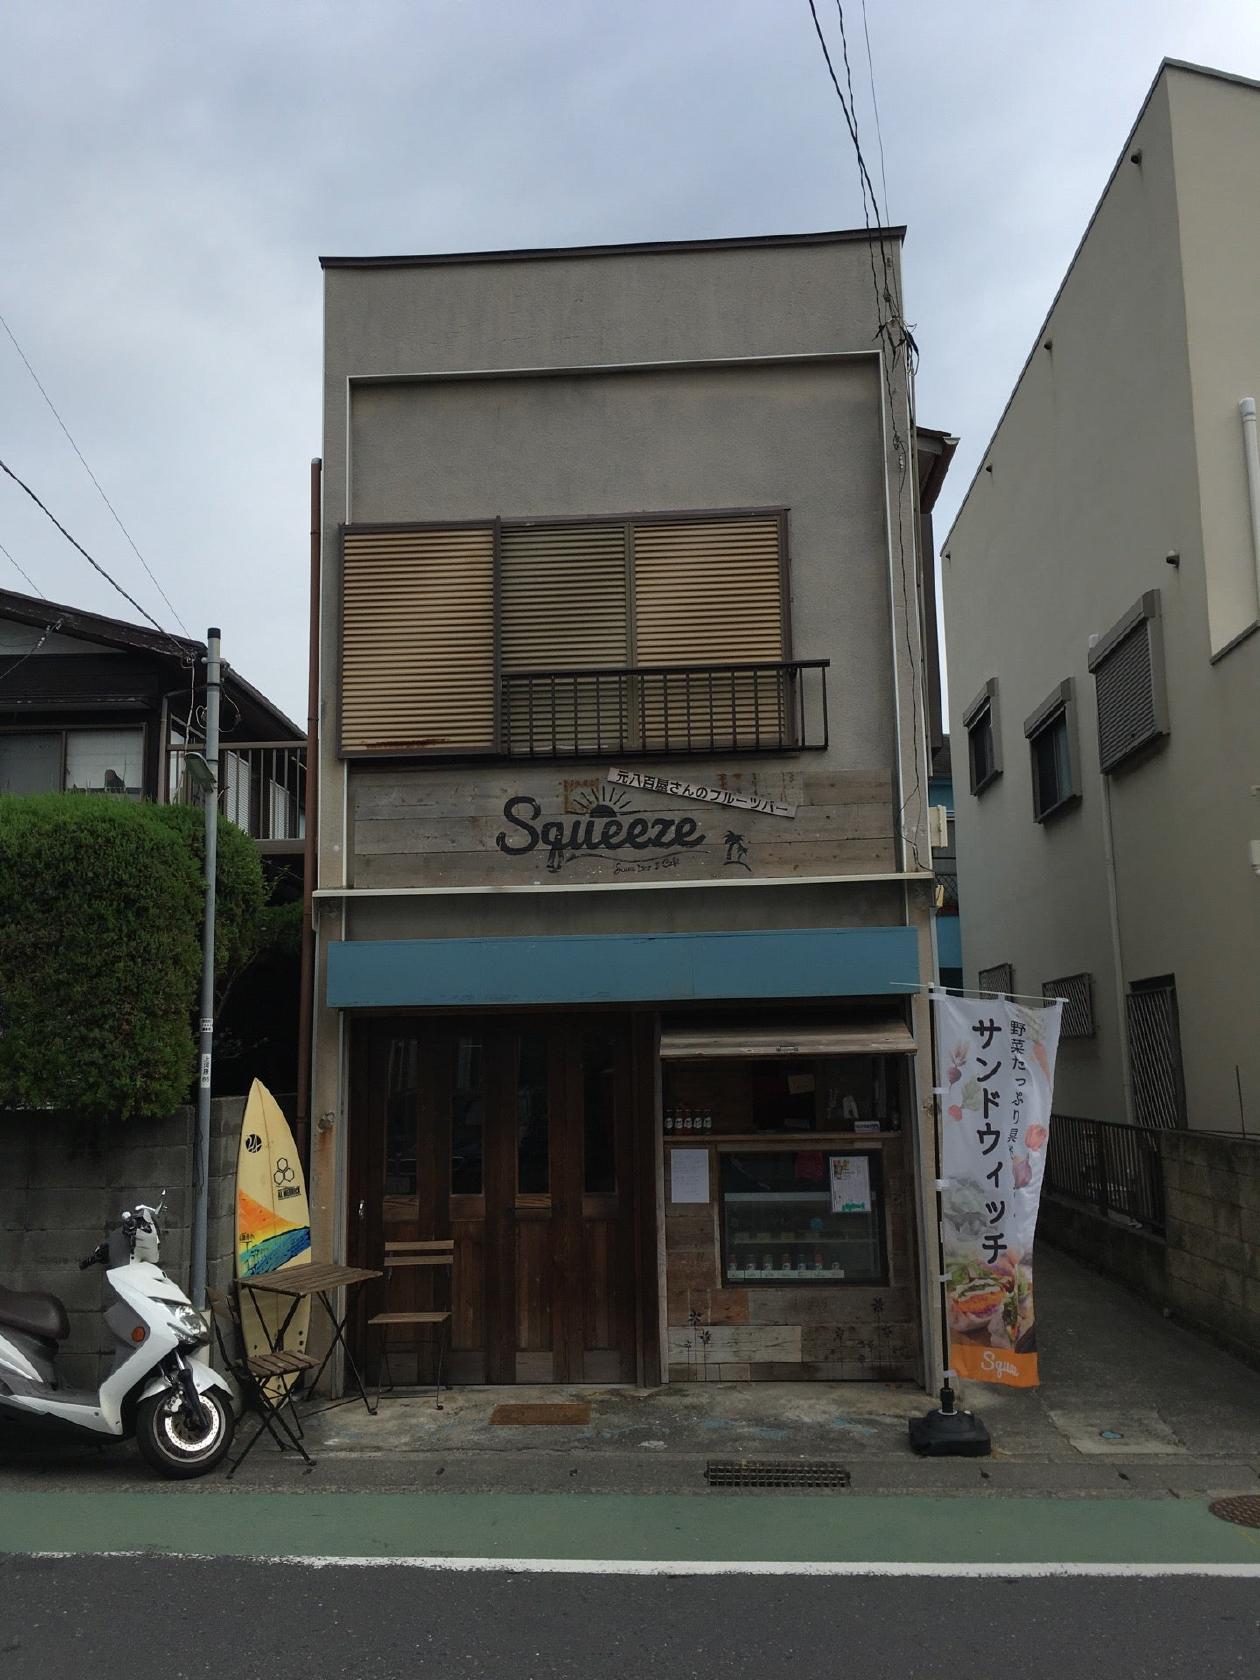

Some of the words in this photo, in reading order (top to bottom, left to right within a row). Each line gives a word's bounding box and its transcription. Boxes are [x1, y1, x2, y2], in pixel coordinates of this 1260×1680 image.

[616, 769, 789, 813] 元八百屋さんのフルーツバー
[495, 795, 707, 873] Squeeze
[972, 1018, 1008, 1264] サンドウィッチ
